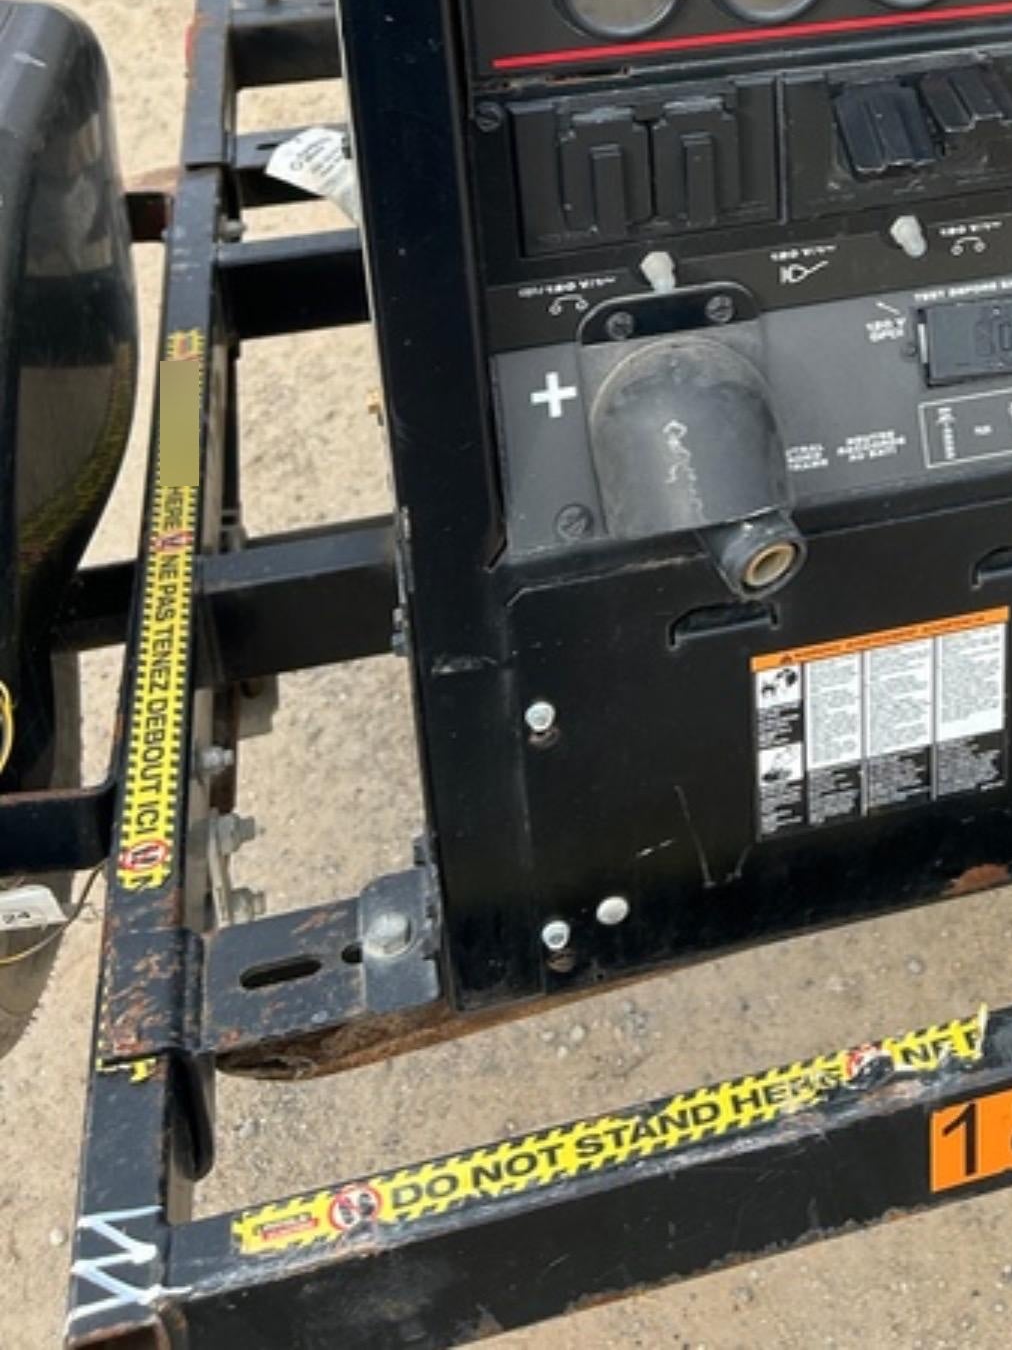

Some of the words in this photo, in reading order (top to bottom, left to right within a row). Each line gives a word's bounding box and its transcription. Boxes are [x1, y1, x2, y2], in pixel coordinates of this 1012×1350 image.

[914, 291, 946, 301] TEST
[158, 554, 180, 581] NE
[155, 584, 177, 622] PAS
[149, 624, 174, 694] TENEZ
[139, 698, 168, 795] DEBOUT
[135, 801, 160, 835] ICI
[391, 1175, 460, 1209] DO
[471, 1144, 564, 1188] NOT
[575, 1100, 721, 1158] STAND
